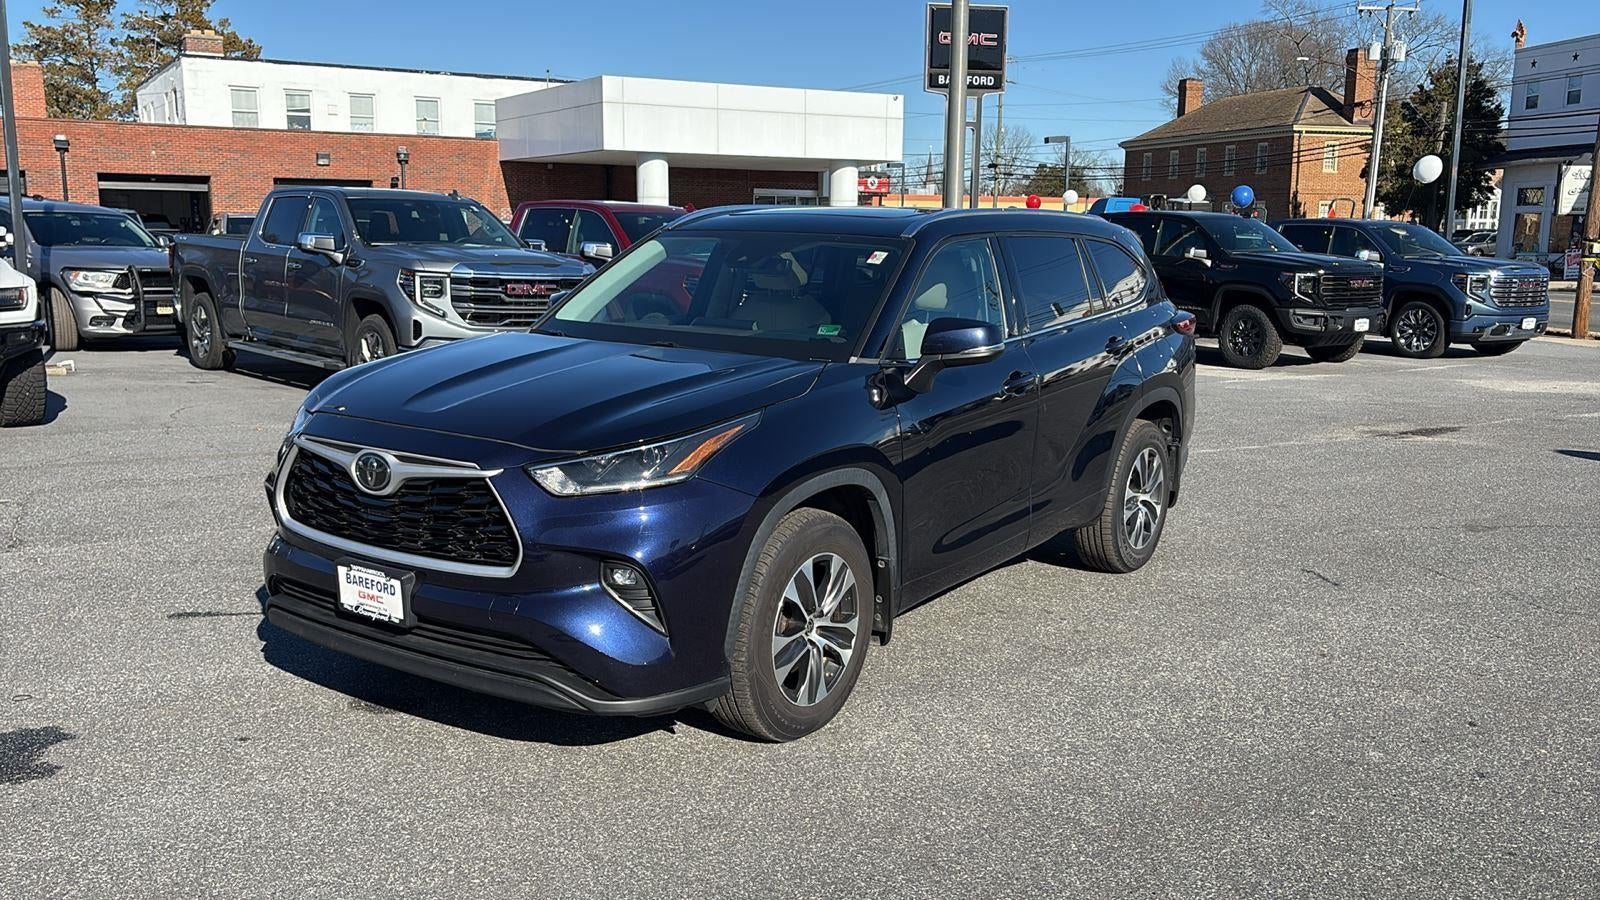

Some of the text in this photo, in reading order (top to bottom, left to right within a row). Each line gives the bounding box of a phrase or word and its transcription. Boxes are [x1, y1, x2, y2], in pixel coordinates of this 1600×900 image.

[506, 283, 557, 295] GMC
[345, 573, 396, 596] BAREFORD
[358, 590, 384, 604] GMC
